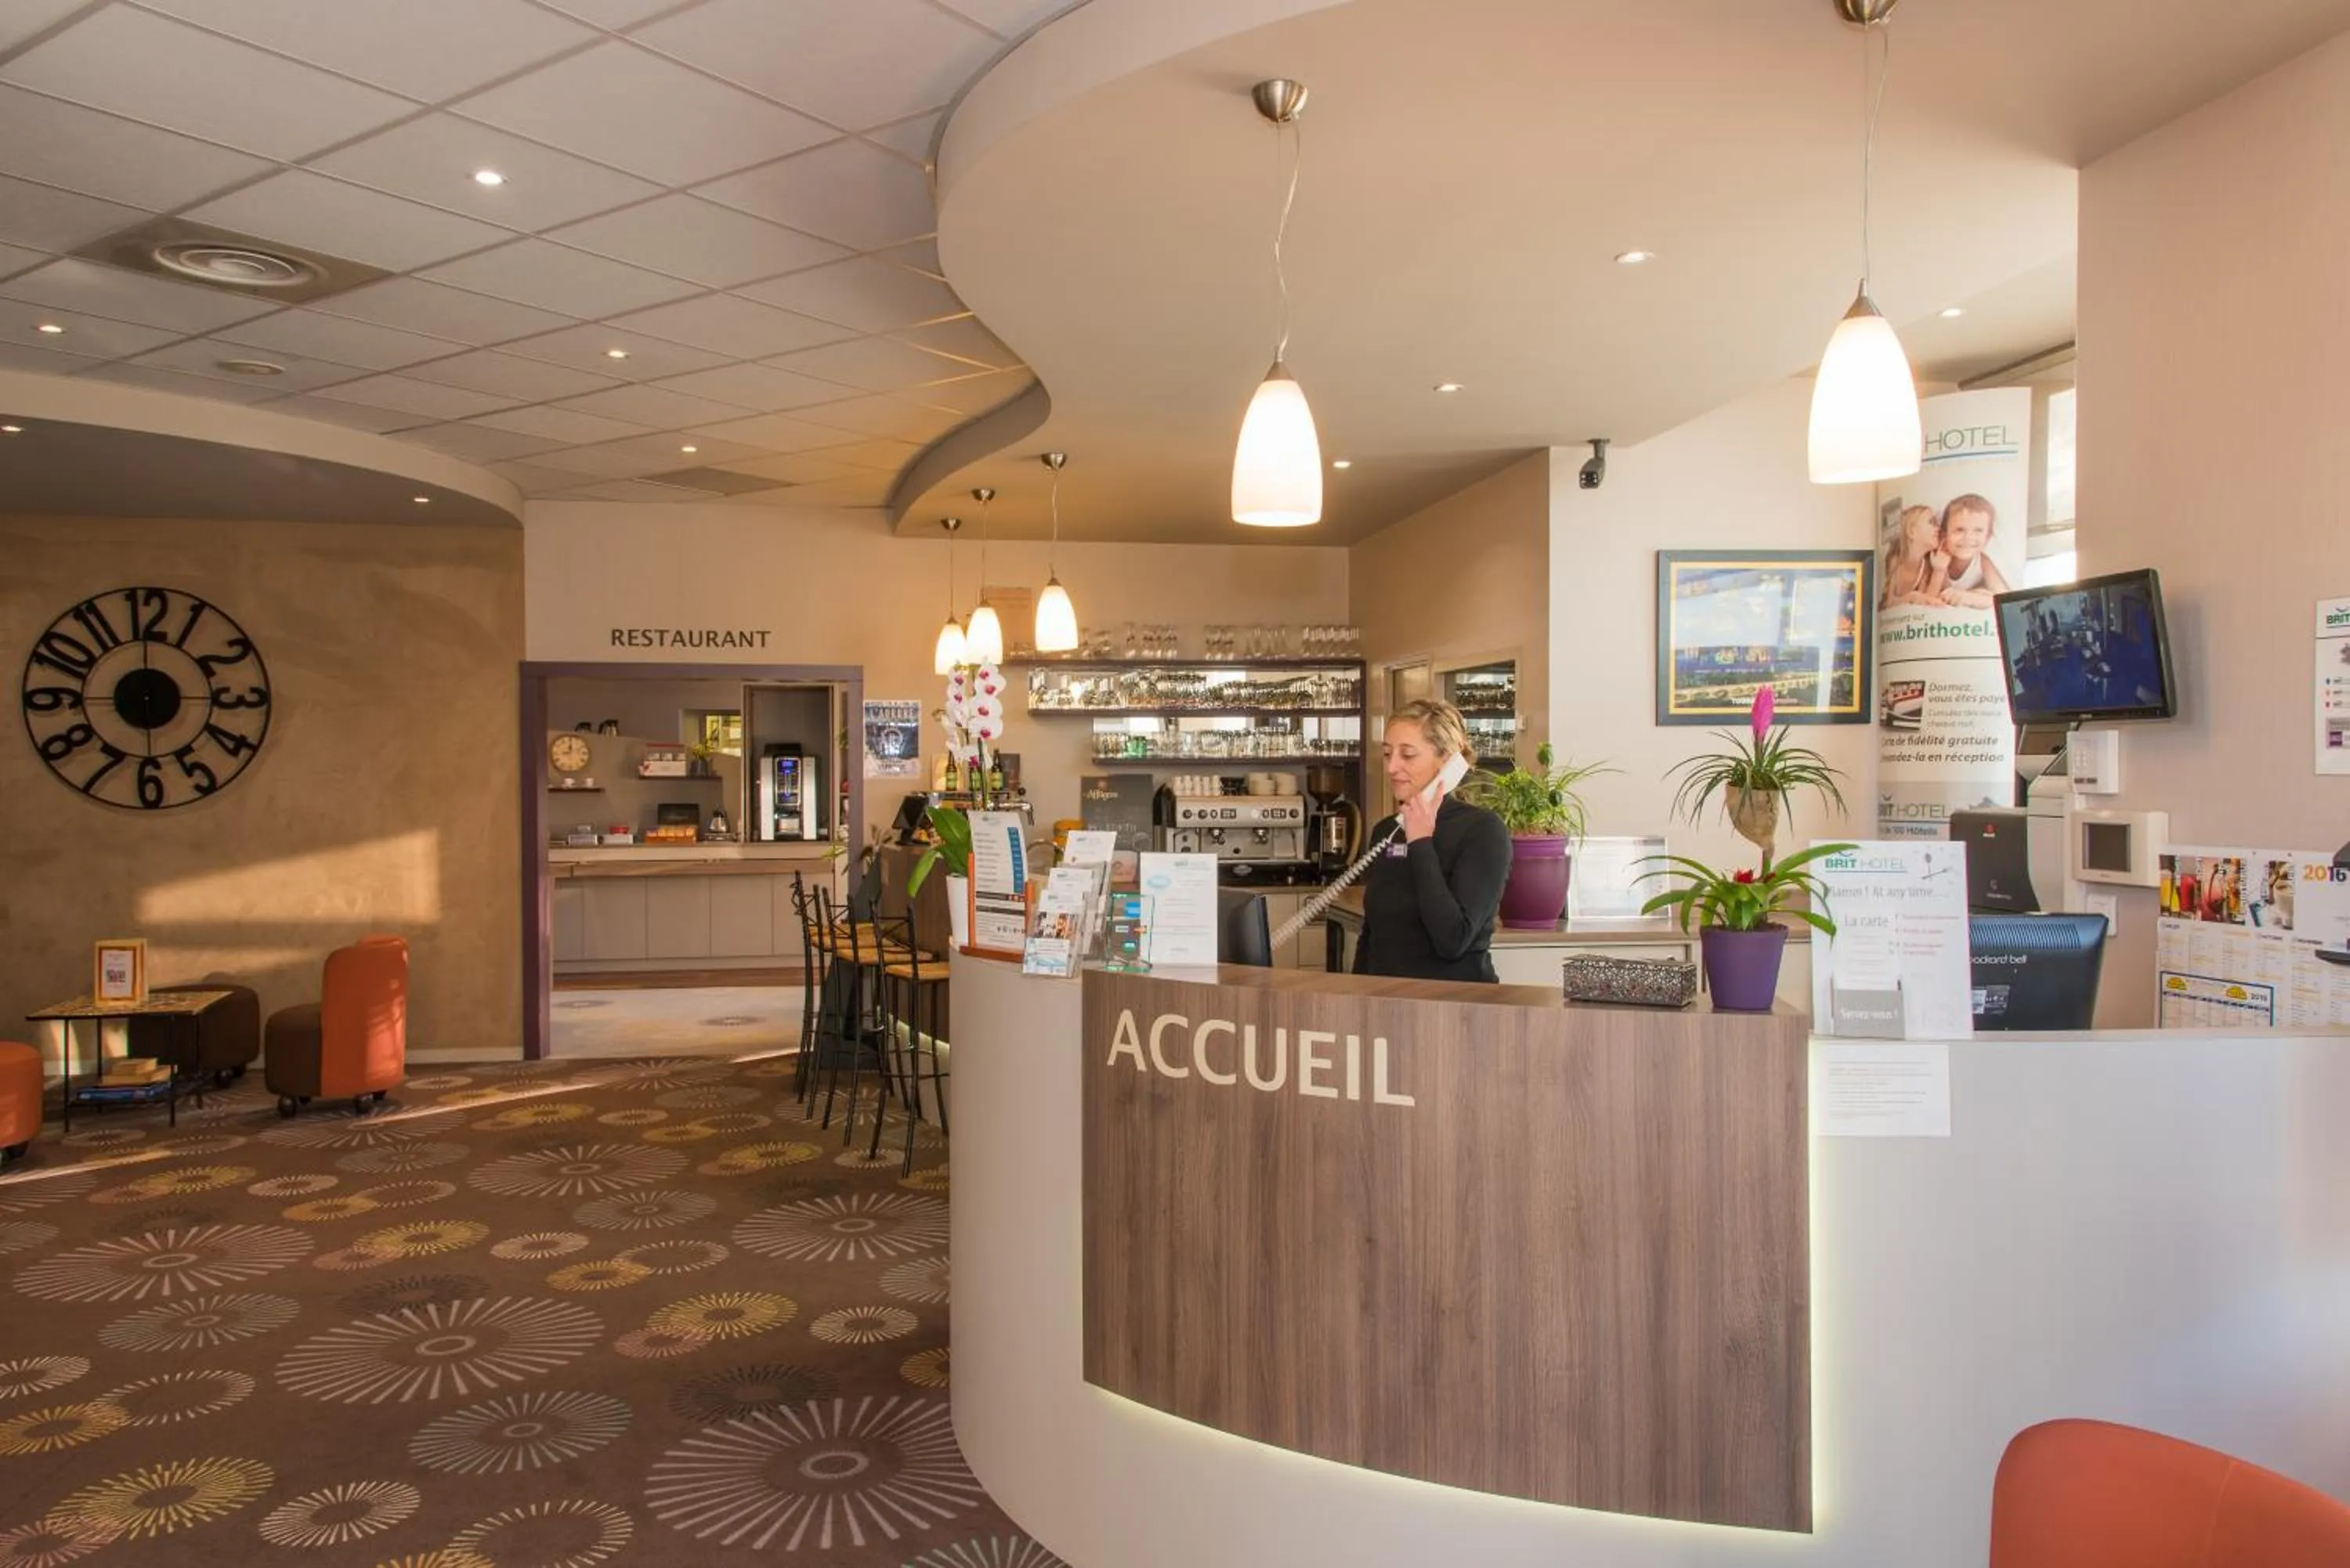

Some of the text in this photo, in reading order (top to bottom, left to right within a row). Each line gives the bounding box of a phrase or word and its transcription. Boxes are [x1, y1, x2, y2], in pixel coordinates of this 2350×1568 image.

[1925, 425, 2019, 452] HOTEL
[74, 600, 122, 652] 11
[125, 589, 168, 642] 12
[175, 602, 207, 649] 1
[2326, 614, 2350, 624] BRIT
[611, 629, 771, 648] RESTAURANT
[1880, 620, 1995, 643] www.brithotel.
[35, 630, 97, 680] 10
[197, 638, 253, 678] 2
[25, 687, 83, 711] 9
[212, 687, 268, 710] 3
[1929, 695, 1953, 703] vous
[42, 723, 94, 761] 8
[205, 723, 258, 757] 4
[1907, 735, 1943, 746] fidélité
[1947, 735, 1998, 747] gratuite
[83, 743, 126, 793] 7
[175, 743, 217, 795] 5
[1928, 753, 1943, 762] en
[1945, 752, 2005, 764] réception
[137, 757, 164, 809] 6
[1896, 803, 1949, 818] HOTEL
[1825, 858, 1905, 869] BRIT HOTEL
[2303, 864, 2347, 882] 2016
[1845, 913, 1858, 927] La
[1107, 1009, 1415, 1107] ACCUEIL
